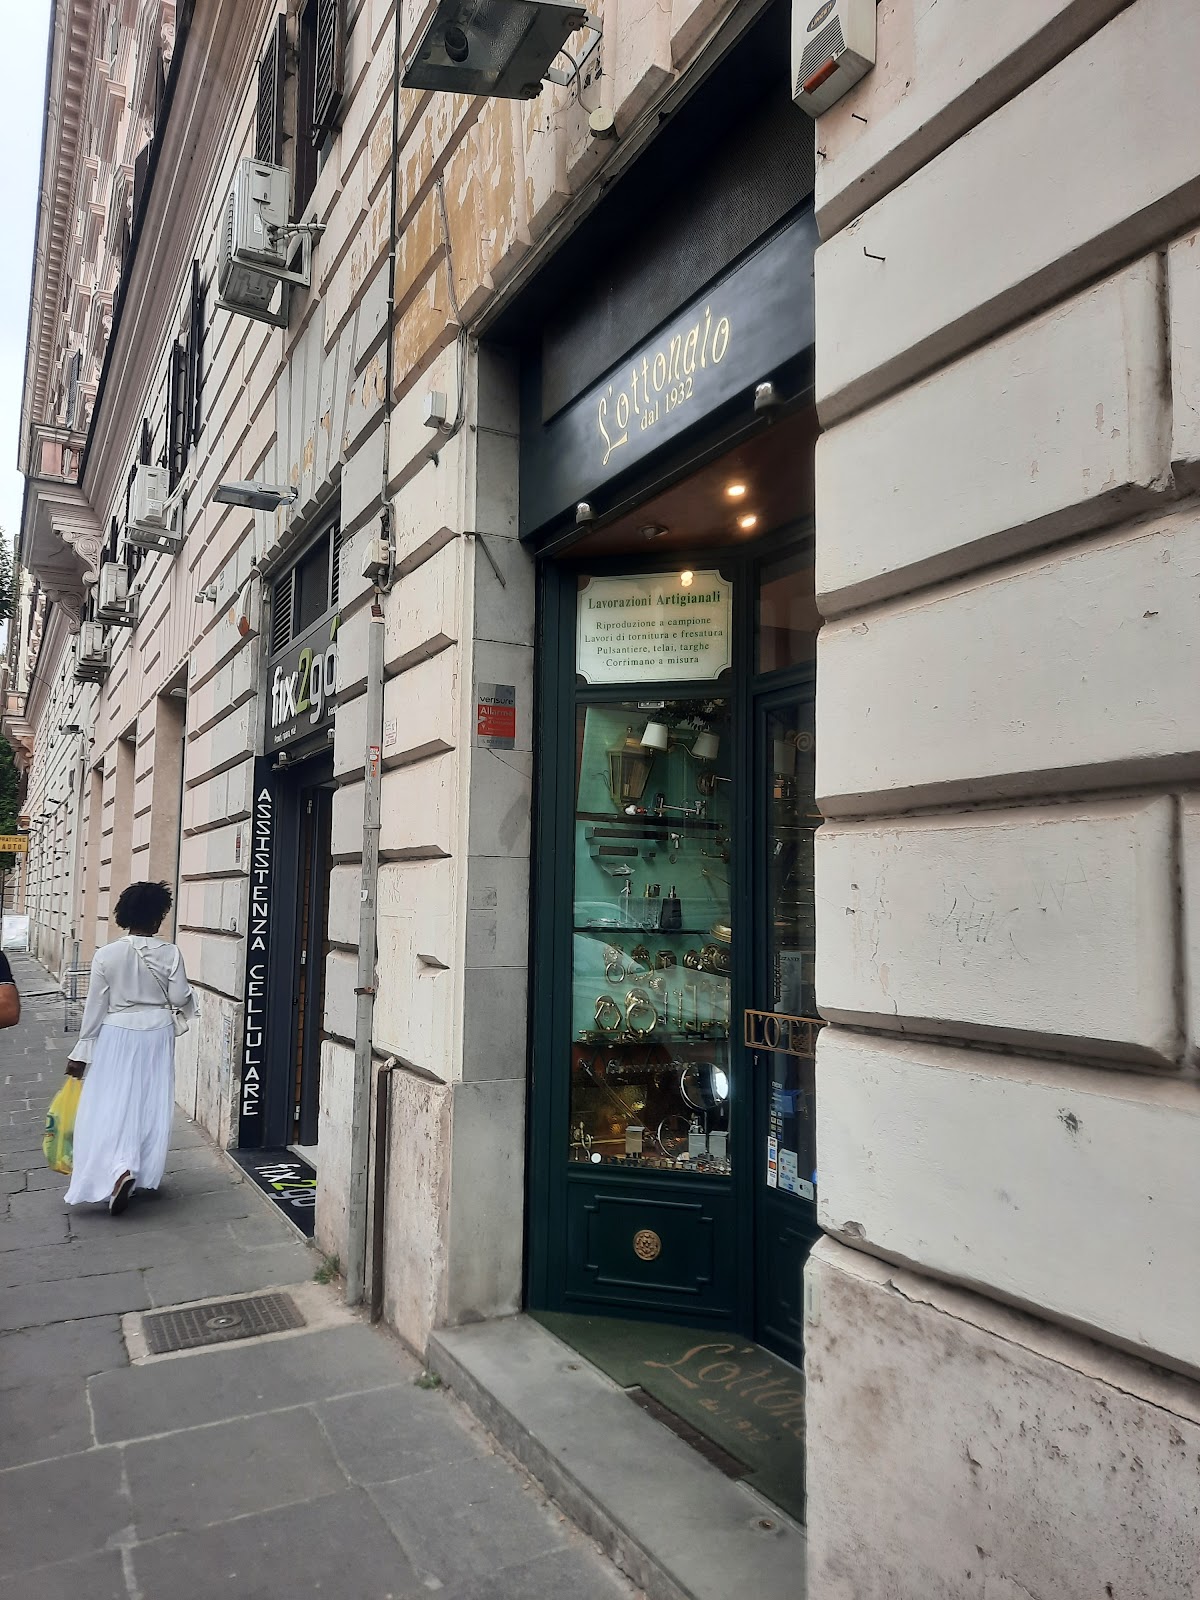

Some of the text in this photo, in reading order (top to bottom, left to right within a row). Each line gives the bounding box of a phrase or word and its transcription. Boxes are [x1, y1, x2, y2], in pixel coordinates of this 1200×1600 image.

[598, 305, 730, 466] L'ottonaio
[640, 377, 694, 431] dal 1932
[588, 591, 721, 609] Lavorazioni Artigianali
[596, 620, 656, 631] Riproduzione
[667, 617, 711, 627] campione
[585, 634, 613, 642] Lavori
[616, 633, 625, 641] di
[628, 631, 669, 641] tornitura
[681, 629, 723, 638] fresatura
[597, 642, 710, 655] Pulsantiere, telai, targhe
[606, 658, 655, 667] Corrimano
[667, 655, 699, 664] misura
[272, 643, 337, 729] fix2go
[480, 696, 514, 705] verisure
[250, 788, 273, 951] ASSISTENZA
[242, 964, 265, 1116] CELLULARE
